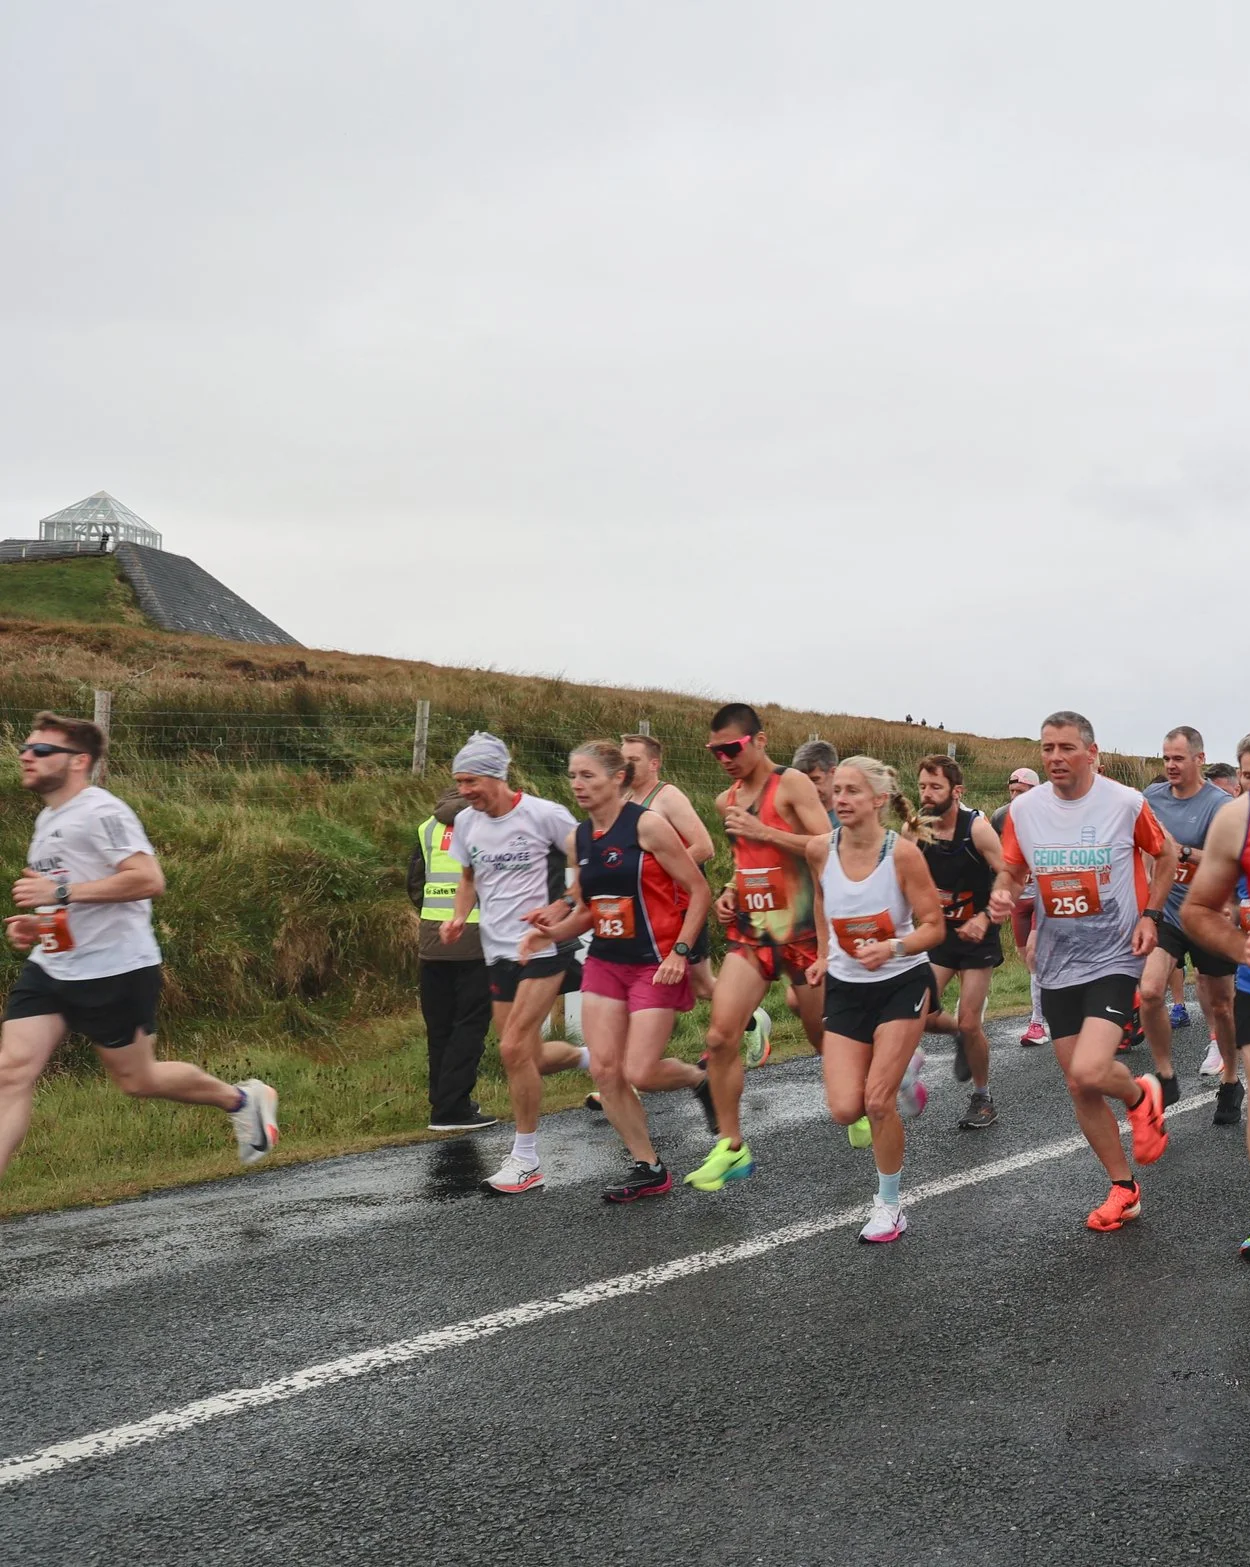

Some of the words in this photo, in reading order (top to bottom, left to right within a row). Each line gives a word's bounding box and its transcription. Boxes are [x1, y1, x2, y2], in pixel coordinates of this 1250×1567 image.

[1069, 847, 1112, 866] COAST
[432, 886, 448, 895] Safe
[744, 892, 774, 910] 101
[1051, 895, 1089, 915] 256
[598, 918, 625, 936] 143
